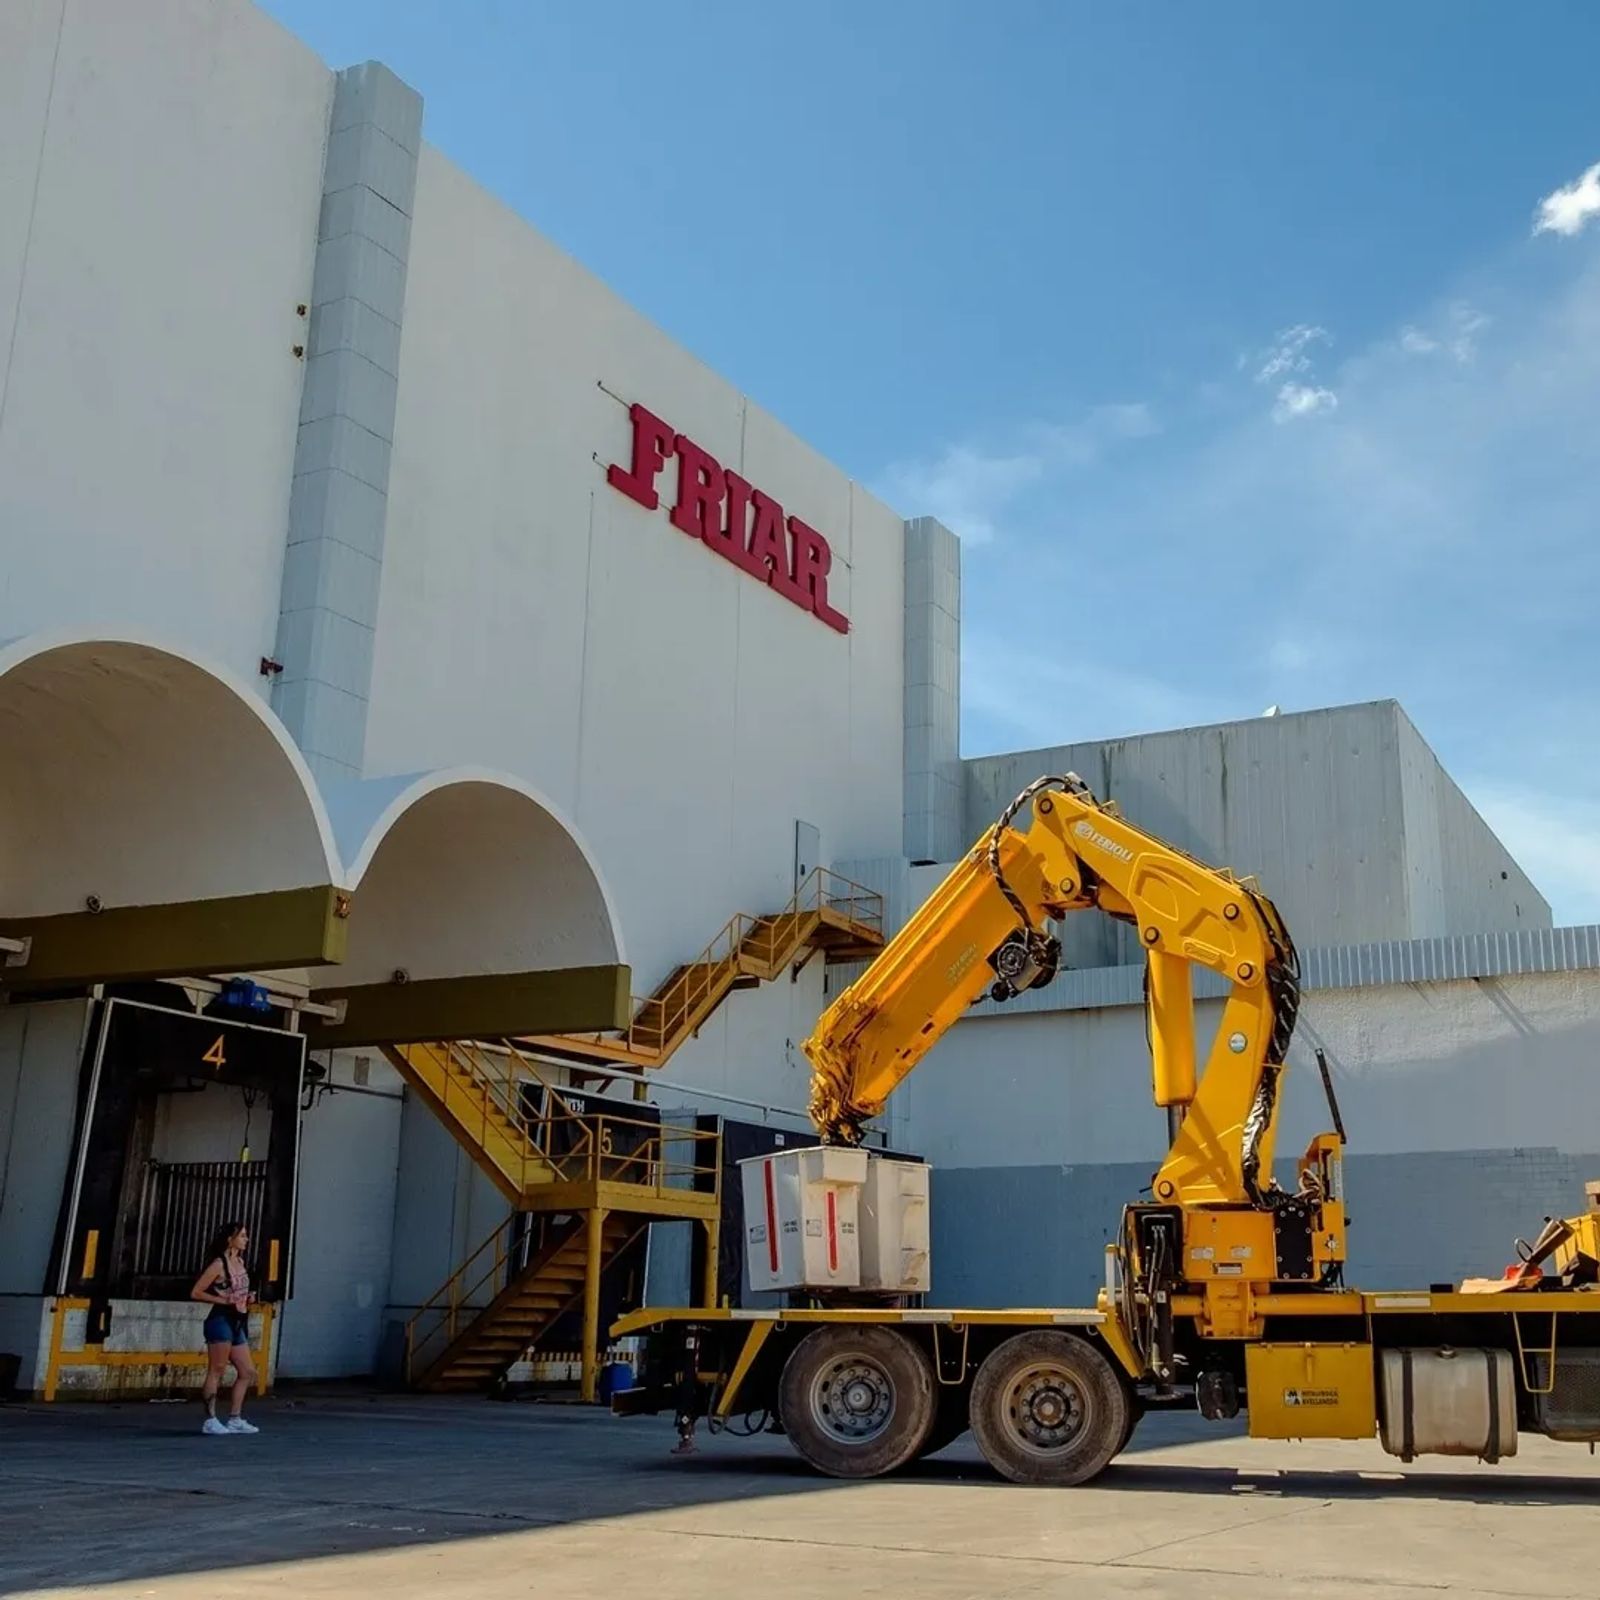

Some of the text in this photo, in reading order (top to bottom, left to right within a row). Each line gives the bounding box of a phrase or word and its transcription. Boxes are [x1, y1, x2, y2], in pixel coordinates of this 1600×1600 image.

[607, 403, 849, 634] FRIAR
[202, 1034, 226, 1070] 4
[602, 1127, 612, 1153] 5
